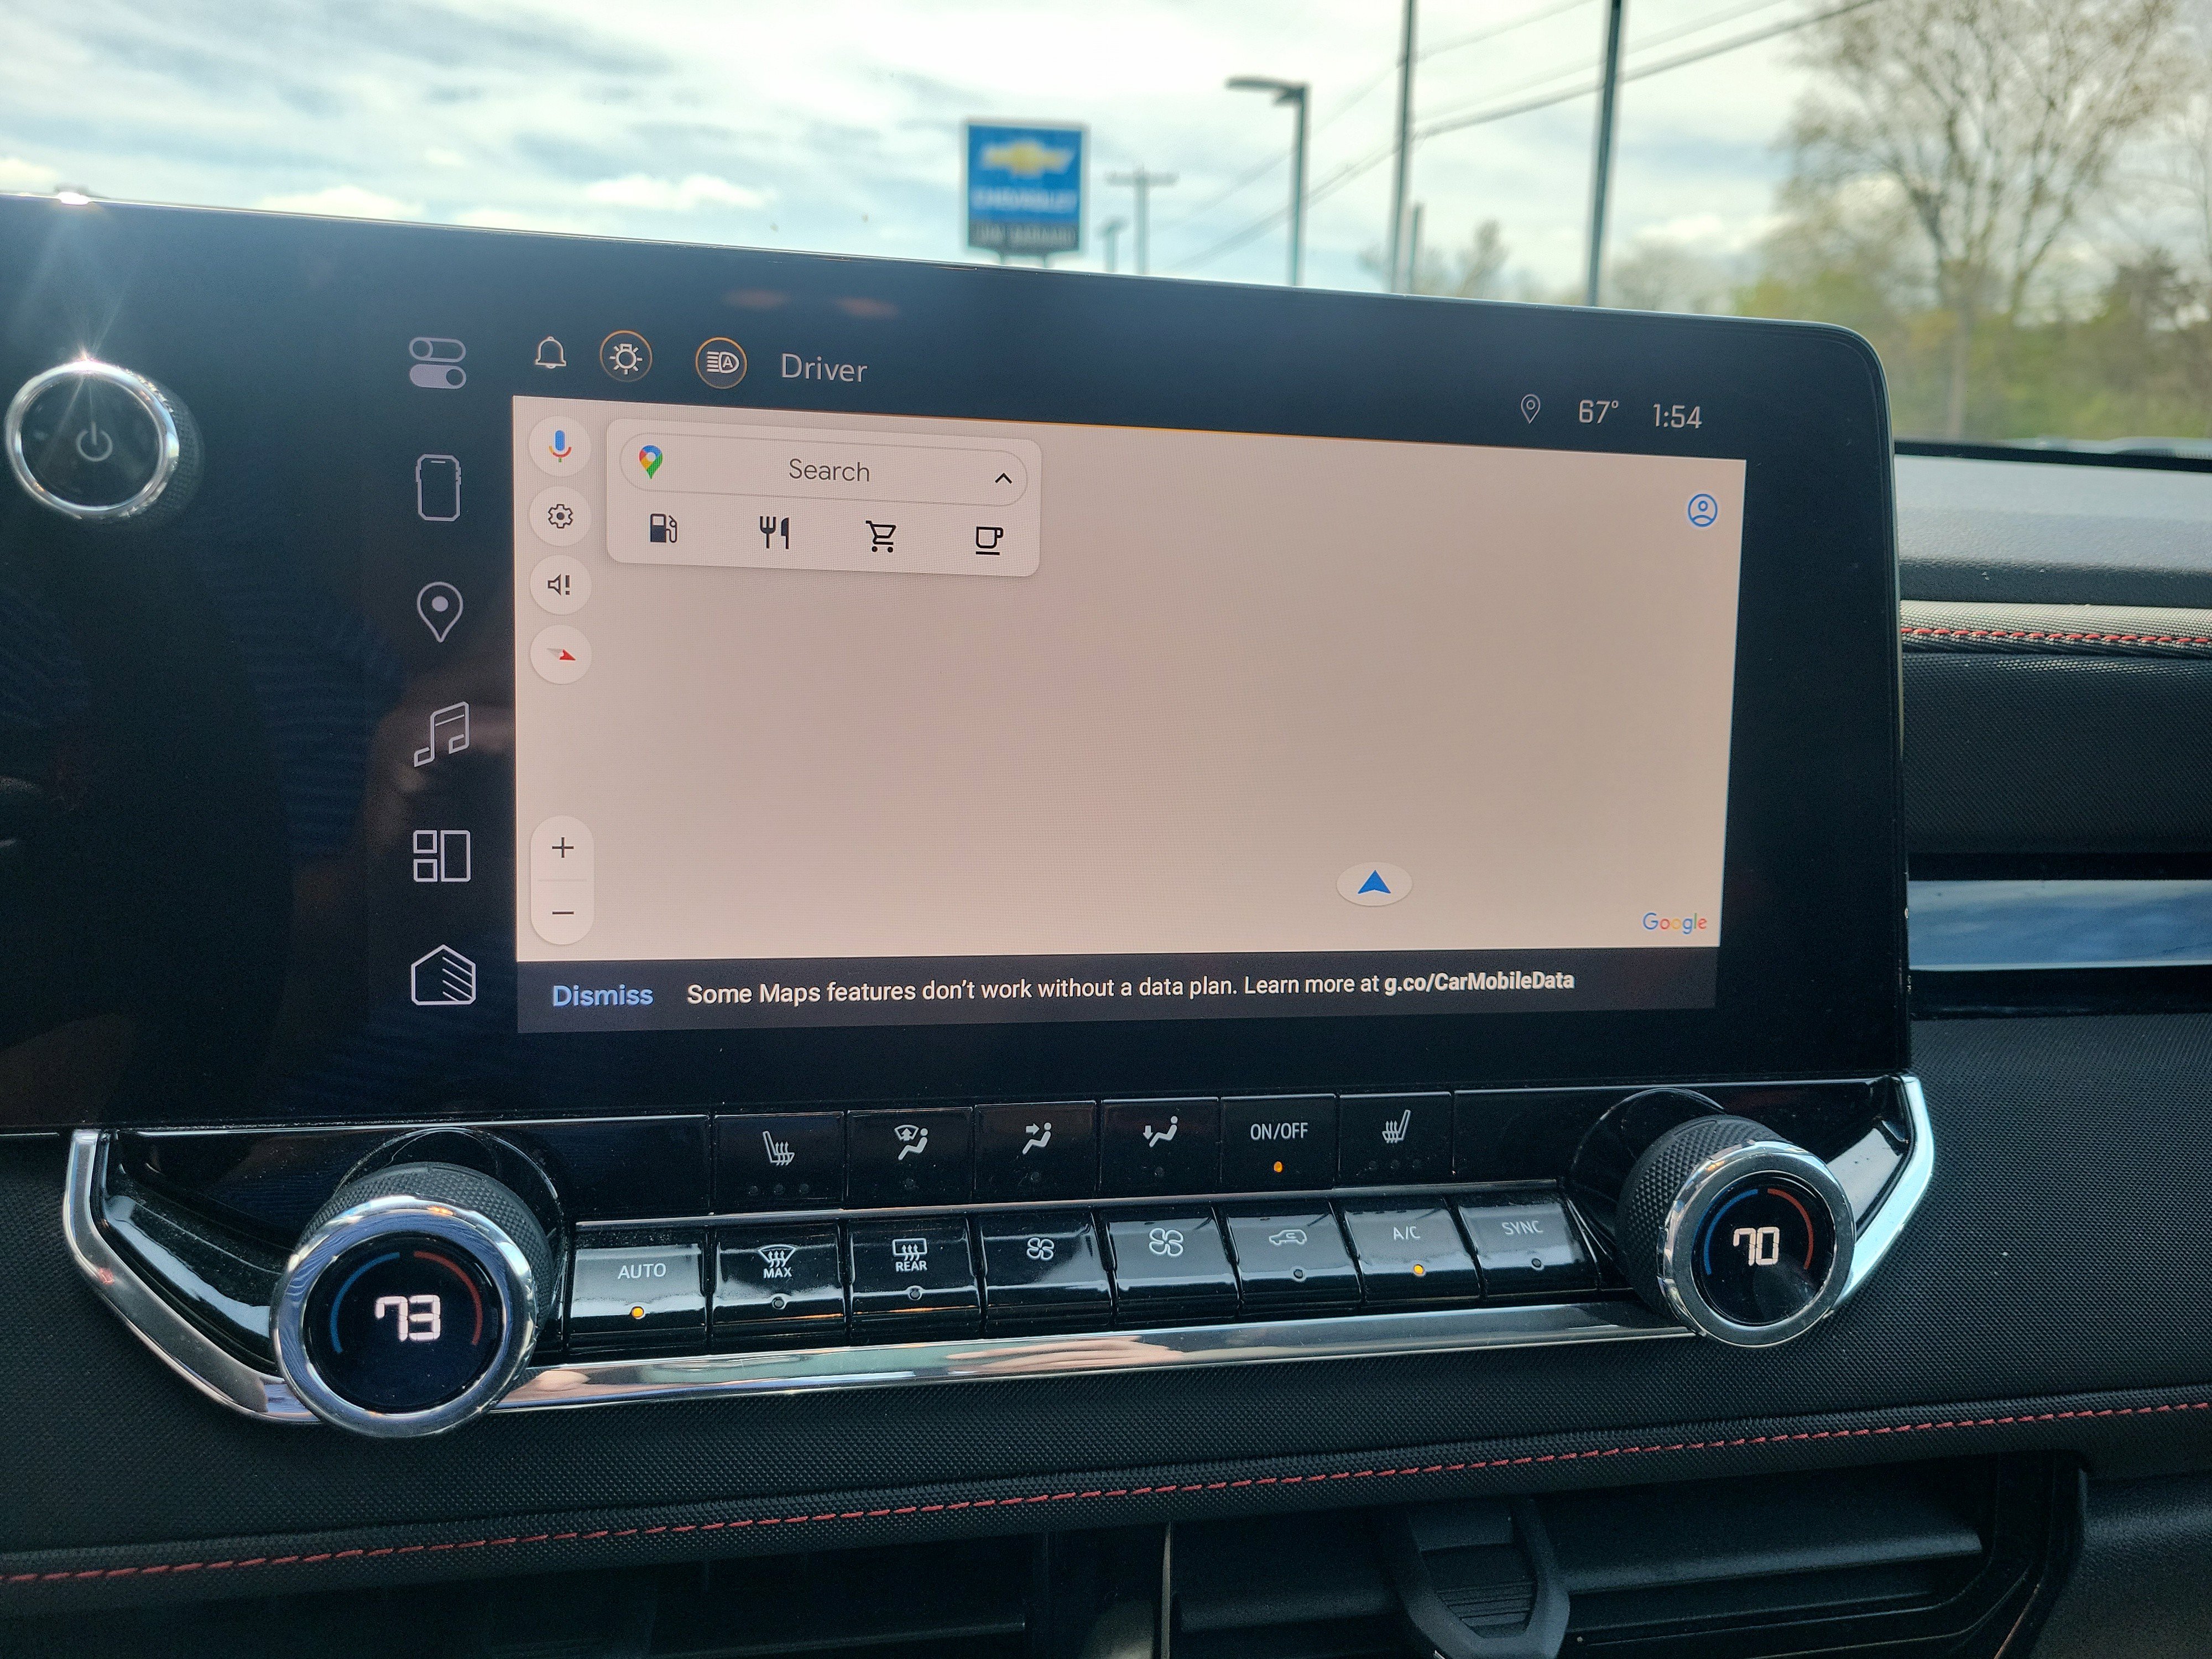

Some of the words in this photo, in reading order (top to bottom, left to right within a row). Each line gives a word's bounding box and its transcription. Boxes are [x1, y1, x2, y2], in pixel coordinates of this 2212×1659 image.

[781, 352, 868, 383] Driver
[1578, 399, 1619, 424] 67°
[1653, 403, 1702, 429] 1:54
[789, 458, 870, 482] Search
[1642, 912, 1708, 935] Google
[553, 984, 654, 1007] Dismiss
[686, 984, 753, 1004] Some
[759, 983, 821, 1007] Maps
[827, 981, 916, 1002] features
[980, 978, 1032, 998] work
[1037, 978, 1115, 997] without
[1120, 981, 1133, 996] a
[1139, 977, 1183, 996] data
[1190, 975, 1238, 1000] plan.
[1244, 976, 1300, 994] Learn
[1305, 978, 1355, 993] more
[1360, 975, 1379, 993] at
[1384, 971, 1575, 997] g.co/CarMobileData
[1250, 1123, 1308, 1141] ON/OFF
[1392, 1226, 1421, 1241] A/C
[1501, 1220, 1543, 1235] SYNC
[1733, 1227, 1780, 1266] 70
[618, 1263, 666, 1280] AUTO
[763, 1267, 792, 1279] MAX
[895, 1260, 927, 1272] REAR
[375, 1295, 441, 1342] 73
